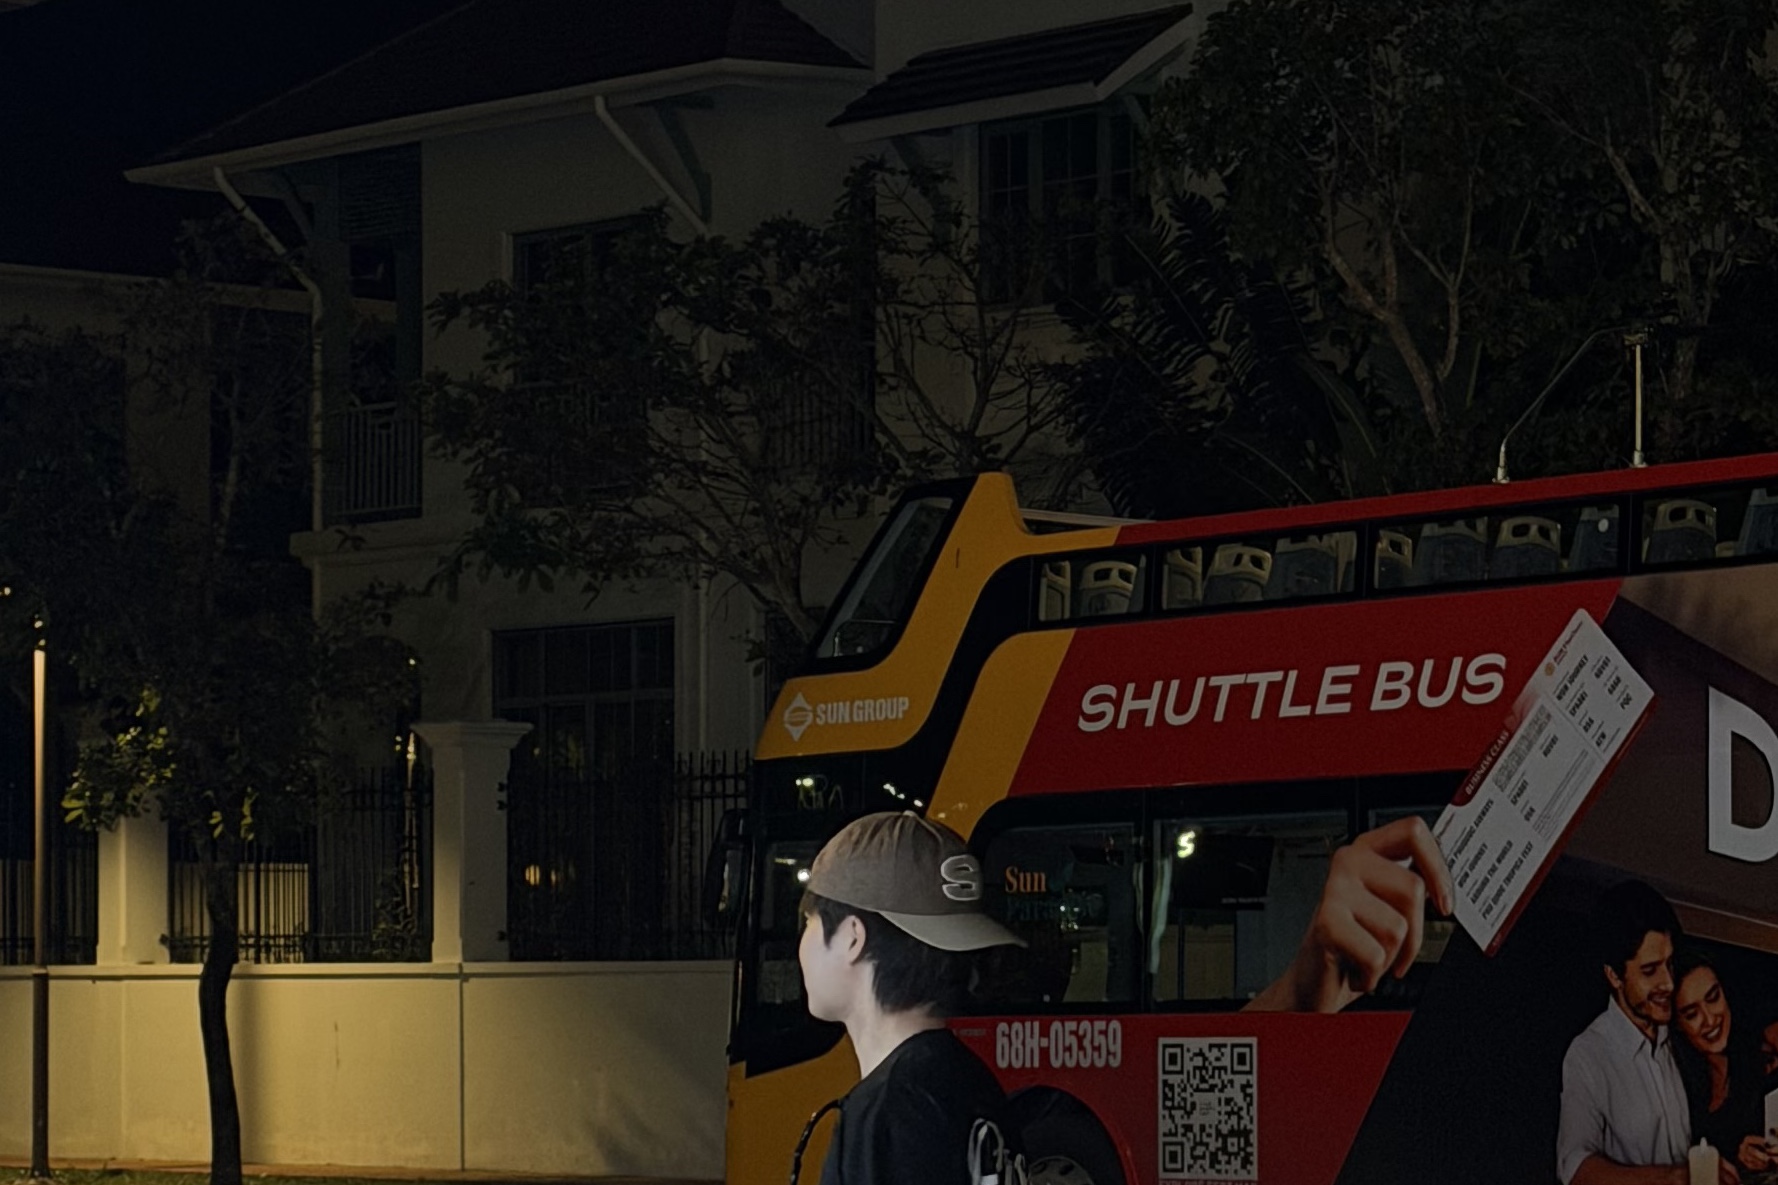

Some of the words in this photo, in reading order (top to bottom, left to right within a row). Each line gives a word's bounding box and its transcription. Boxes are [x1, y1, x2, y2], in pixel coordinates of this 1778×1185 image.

[816, 700, 850, 726] SUN
[853, 696, 909, 723] GROUP
[1077, 664, 1361, 733] SHUTTLE
[1370, 653, 1507, 712] BUS
[1463, 753, 1493, 796] BUSINESS
[1488, 727, 1510, 758] CLASS
[1708, 684, 1778, 864] D
[940, 854, 989, 901] S
[1004, 865, 1047, 894] Sun
[995, 1019, 1122, 1069] 68H-05359
